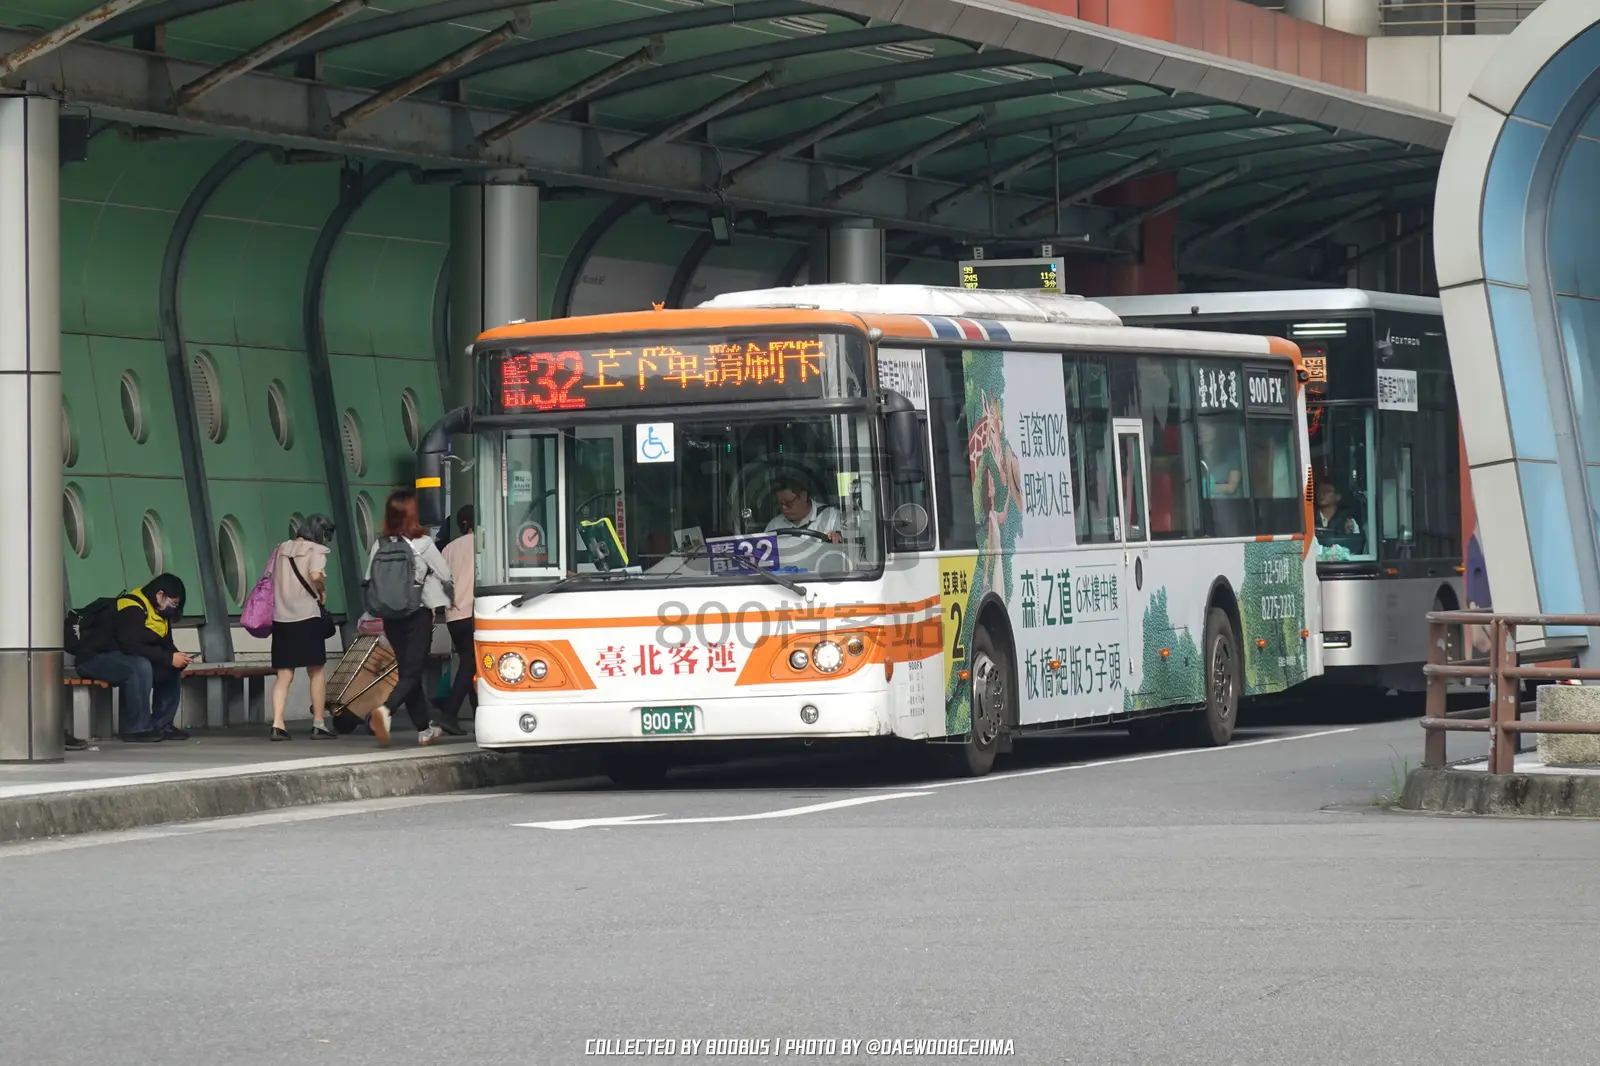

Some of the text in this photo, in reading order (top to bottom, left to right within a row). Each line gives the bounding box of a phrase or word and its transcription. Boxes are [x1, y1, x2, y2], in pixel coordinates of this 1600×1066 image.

[1391, 335, 1420, 346] FOXTRON
[530, 351, 586, 410] 32
[583, 340, 825, 390] 上下車請刷卡
[1199, 367, 1239, 408] 臺北客運
[1249, 377, 1283, 403] 900 FX
[1024, 471, 1072, 517] 即刻入住
[713, 558, 739, 573] BL
[943, 570, 967, 596] 亞東站
[1020, 568, 1073, 628] 森之道
[1076, 573, 1118, 612] 6米樓中樓
[950, 602, 964, 659] 2
[596, 641, 737, 678] 臺北客運
[643, 712, 693, 731] 900 FX
